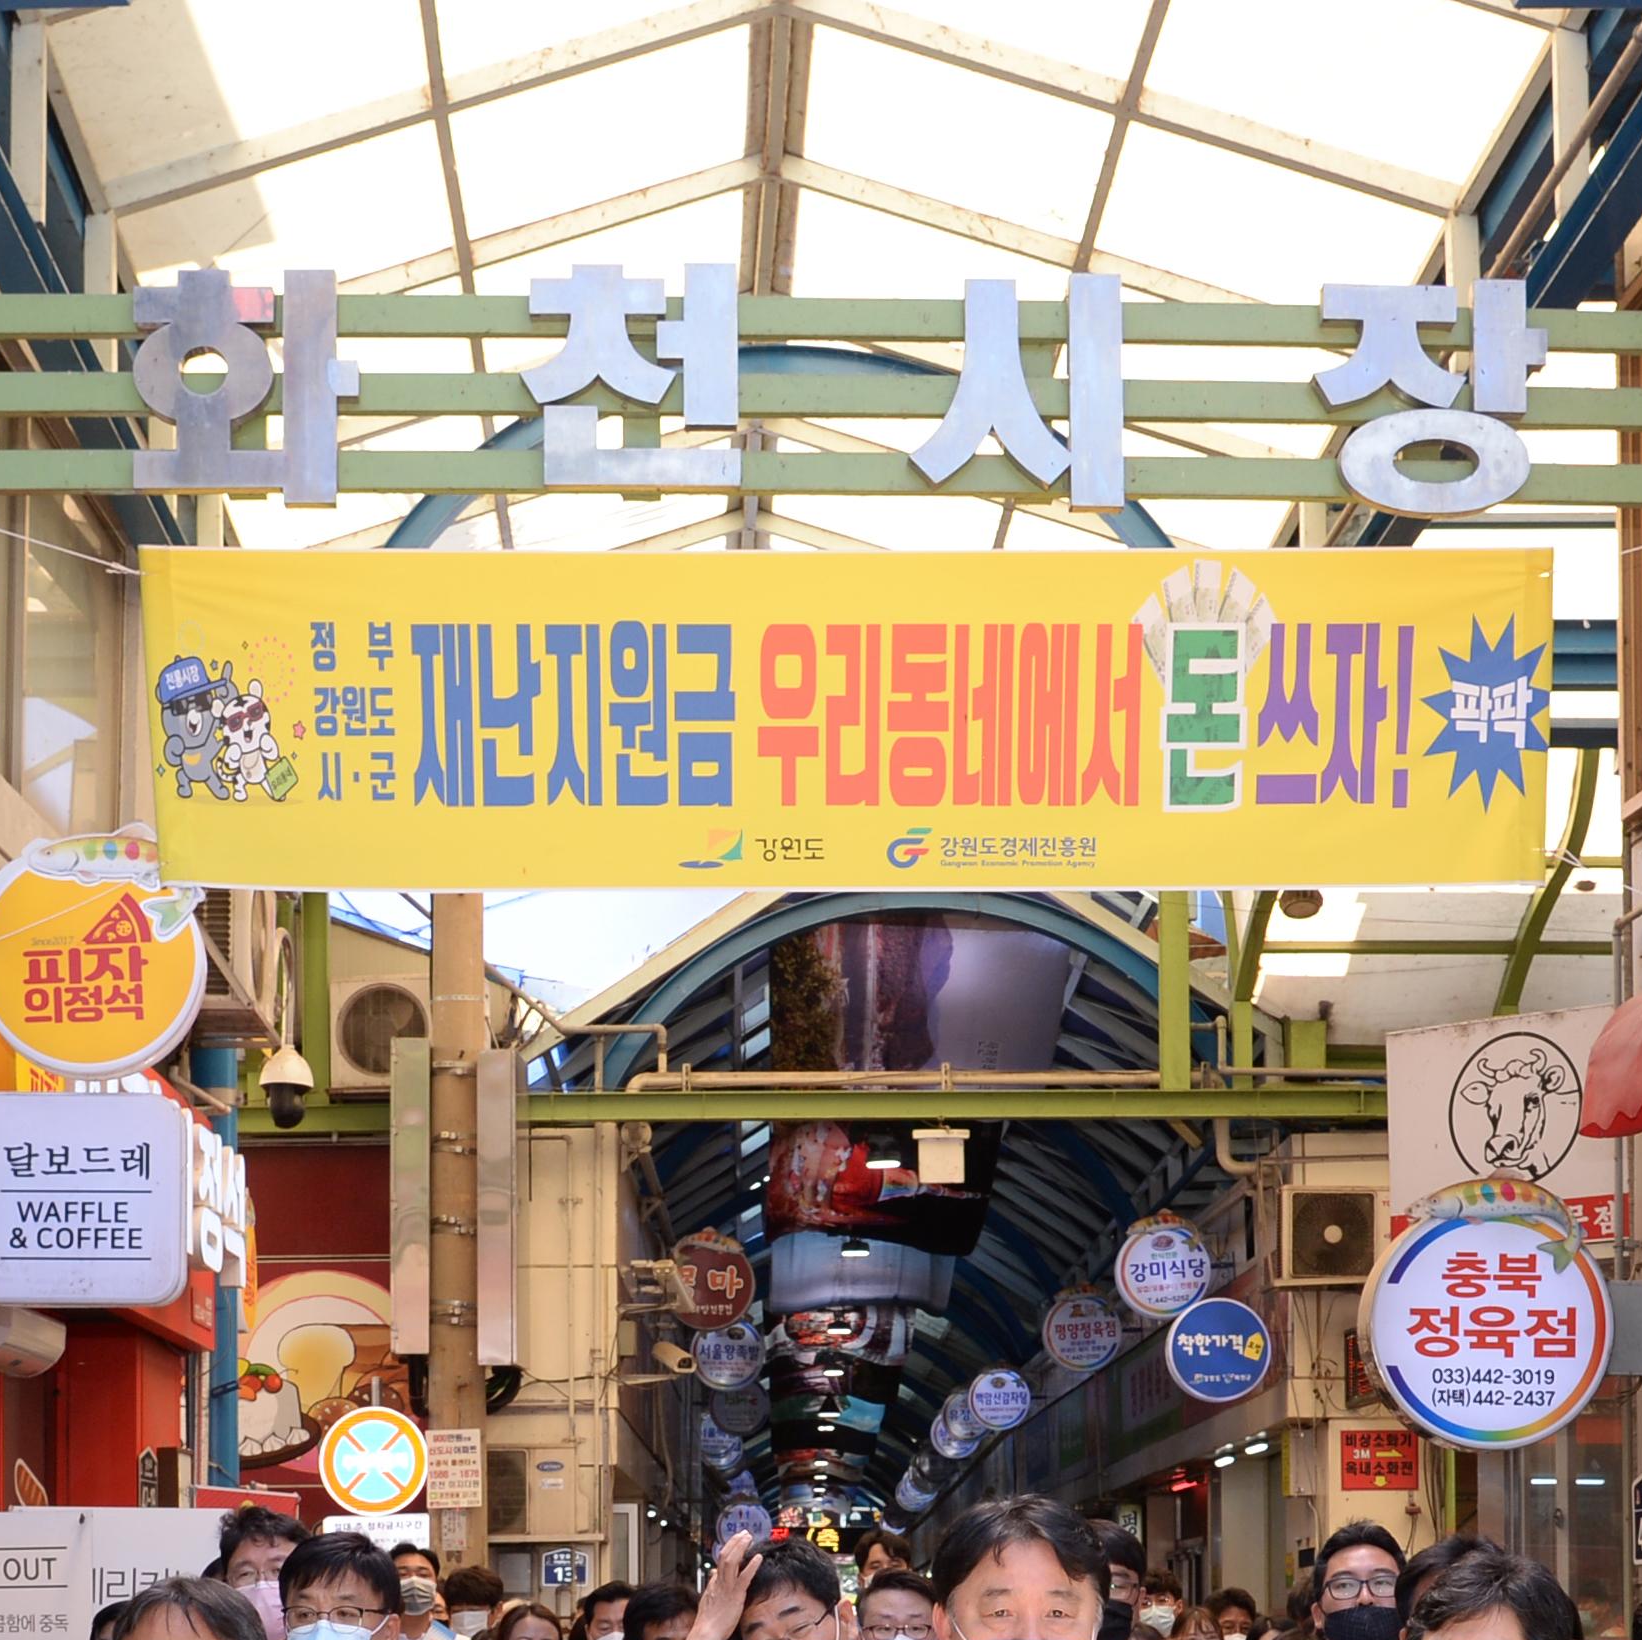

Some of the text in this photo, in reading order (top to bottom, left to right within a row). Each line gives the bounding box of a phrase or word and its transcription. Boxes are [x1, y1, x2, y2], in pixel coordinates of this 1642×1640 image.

[132, 262, 1547, 518] 화천시장
[314, 686, 396, 738] 강원도
[410, 621, 1534, 813] 재난지원금 우리동네에서 돈 쓰자! 팍팍
[755, 837, 825, 862] 강원도
[940, 836, 1097, 857] 강원도경제진흥원
[940, 859, 1096, 869] Gangwon Economic Promotion Agency
[22, 945, 150, 985] 피자
[24, 983, 145, 1024] 의정석
[4, 1141, 152, 1180] 달보드레
[17, 1201, 129, 1223] WAFFLE
[9, 1227, 143, 1249] & COFFEE
[1129, 1258, 1207, 1283] 강미식당
[1441, 1251, 1542, 1298] 충북
[1406, 1306, 1577, 1358] 정육점
[1177, 1333, 1244, 1356] 착한가격
[1432, 1366, 1555, 1387] 033)442-3019
[1432, 1388, 1556, 1408] (자택)442-2437
[1345, 1434, 1412, 1447] 비상소화기
[1353, 1449, 1371, 1459] 3M
[1345, 1461, 1414, 1476] 옥내소화전
[3, 1558, 57, 1581] OUT
[39, 1613, 69, 1633] 중독
